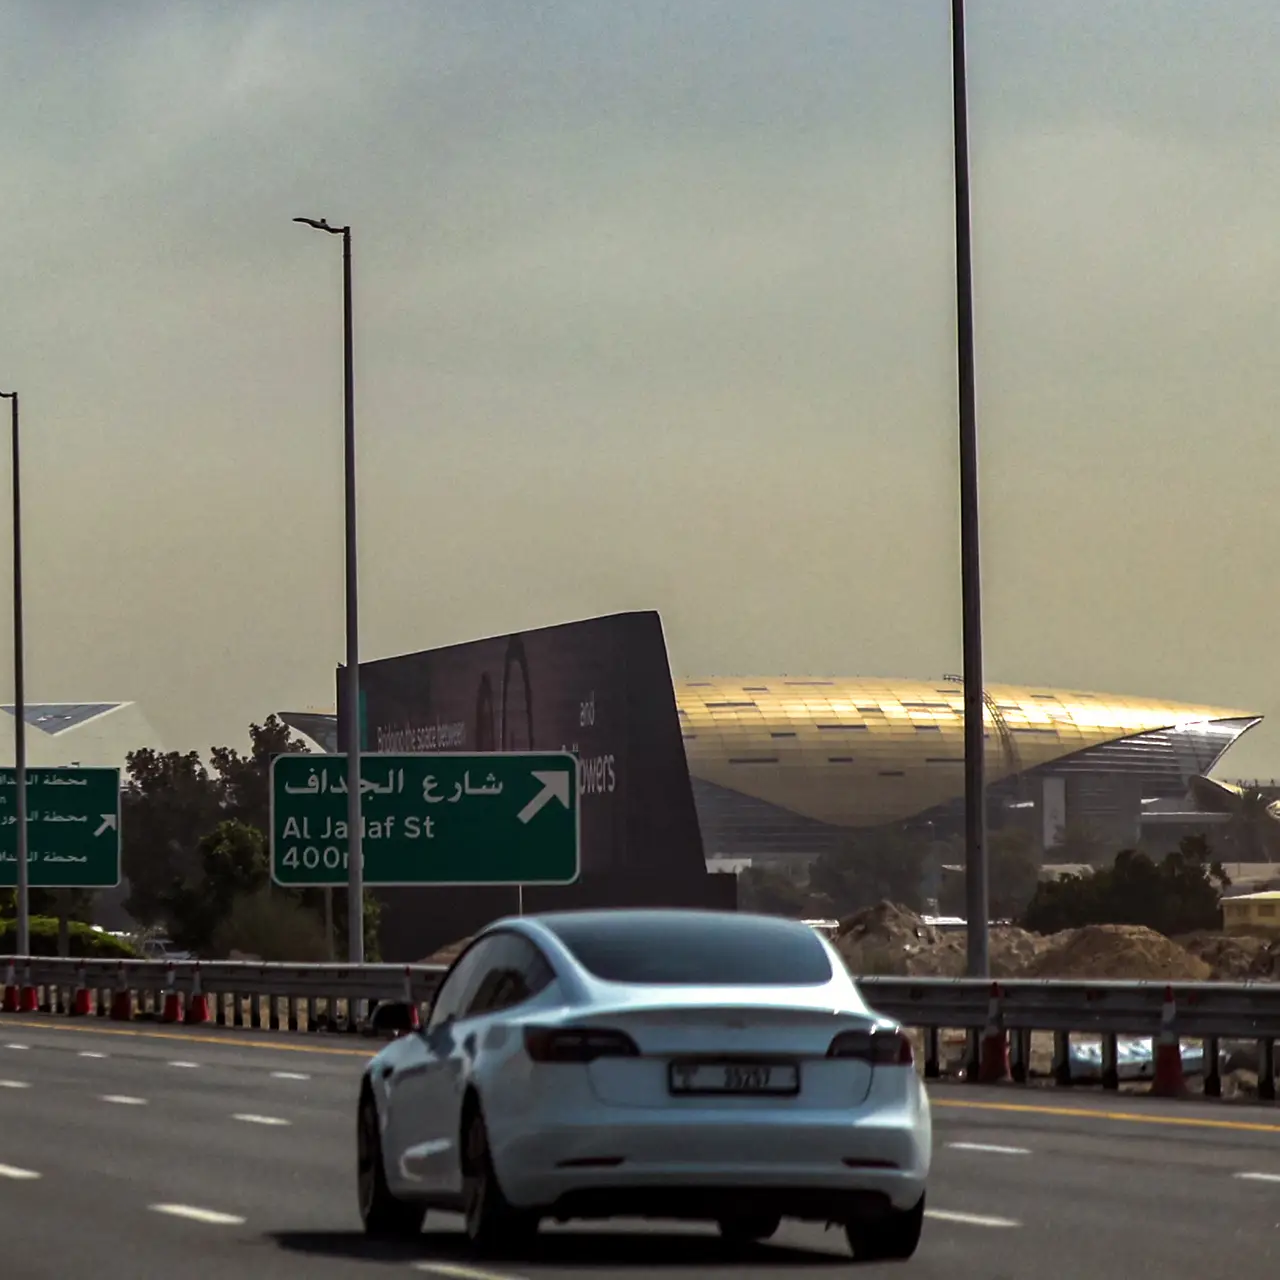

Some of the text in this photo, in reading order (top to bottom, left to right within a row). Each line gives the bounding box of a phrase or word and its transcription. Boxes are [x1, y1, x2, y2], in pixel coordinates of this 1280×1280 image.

[580, 691, 595, 726] and
[43, 774, 88, 786] محطة
[422, 769, 503, 803] شارع
[1, 812, 88, 825] محطة الور
[282, 816, 310, 839] Al
[404, 817, 435, 839] St
[43, 852, 88, 862] محطة
